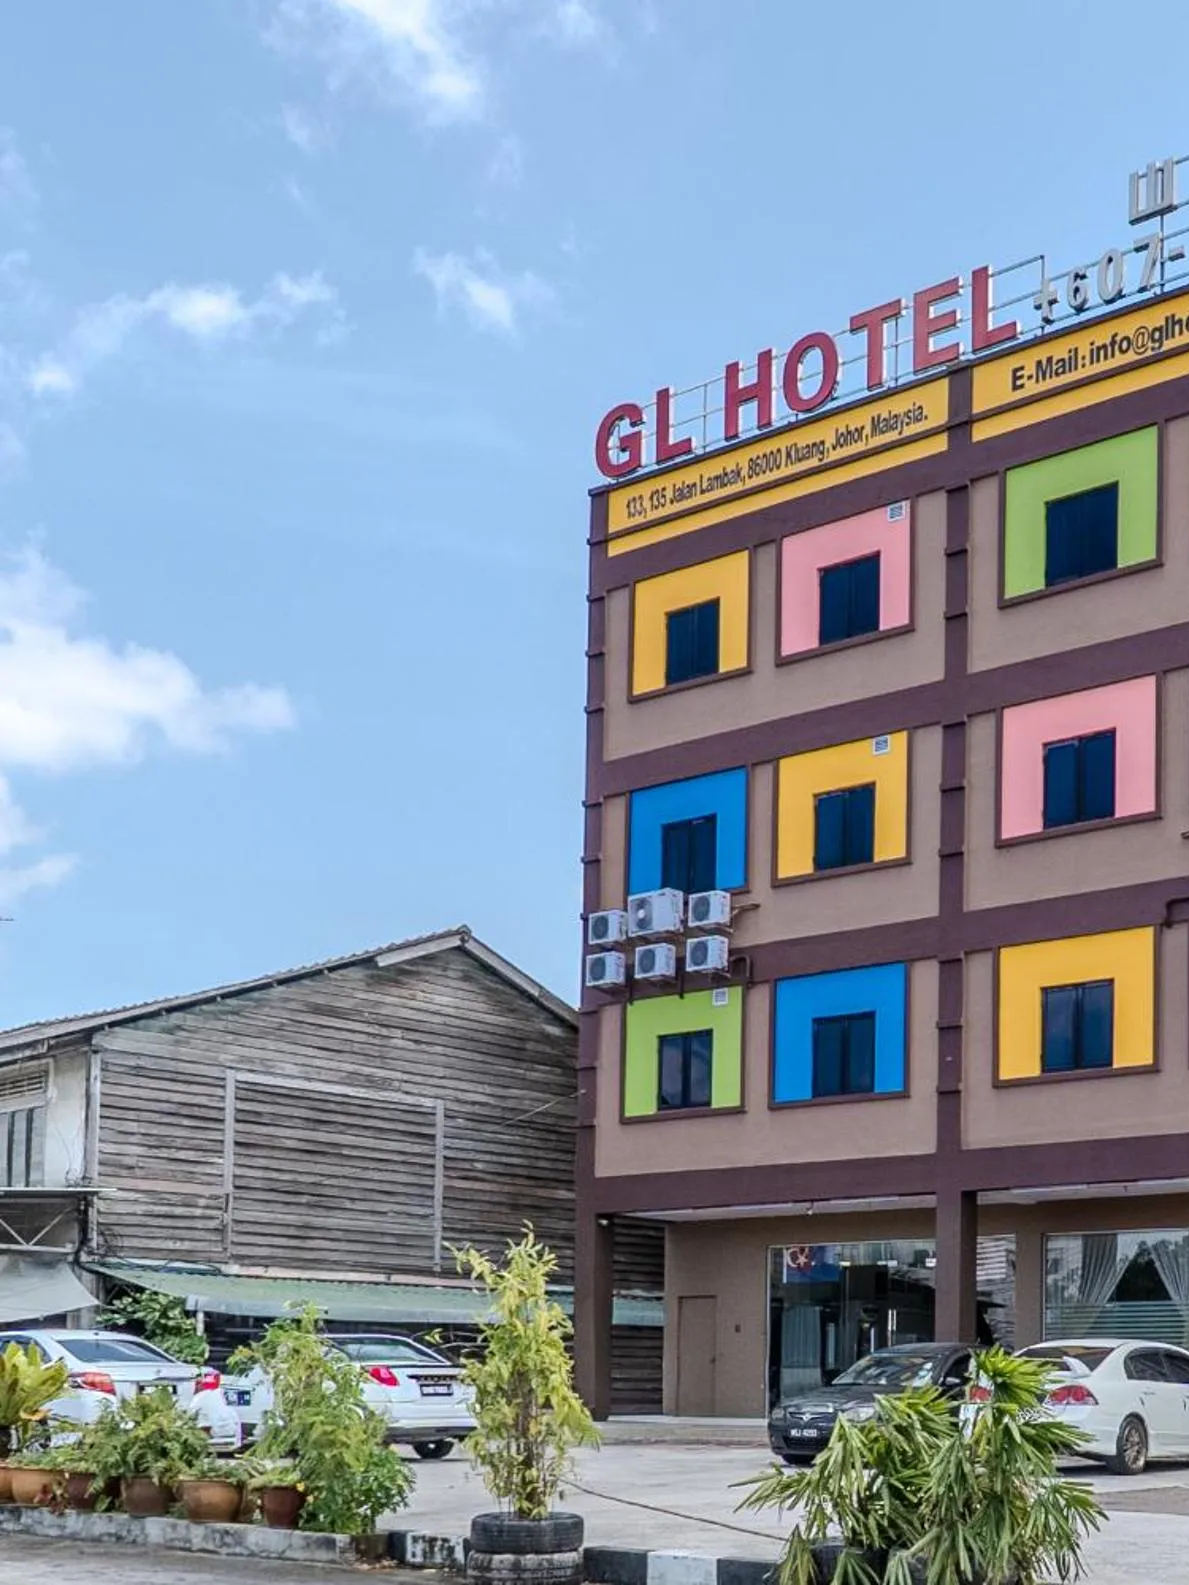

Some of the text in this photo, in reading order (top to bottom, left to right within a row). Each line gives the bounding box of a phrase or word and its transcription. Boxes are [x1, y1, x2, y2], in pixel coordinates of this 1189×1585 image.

[595, 264, 1021, 479] GL HOTEL
[650, 487, 667, 512] 135
[670, 480, 698, 505] Jalan
[700, 462, 746, 495] Lambak,
[747, 448, 782, 480] 86000
[785, 439, 830, 468] Kluang,
